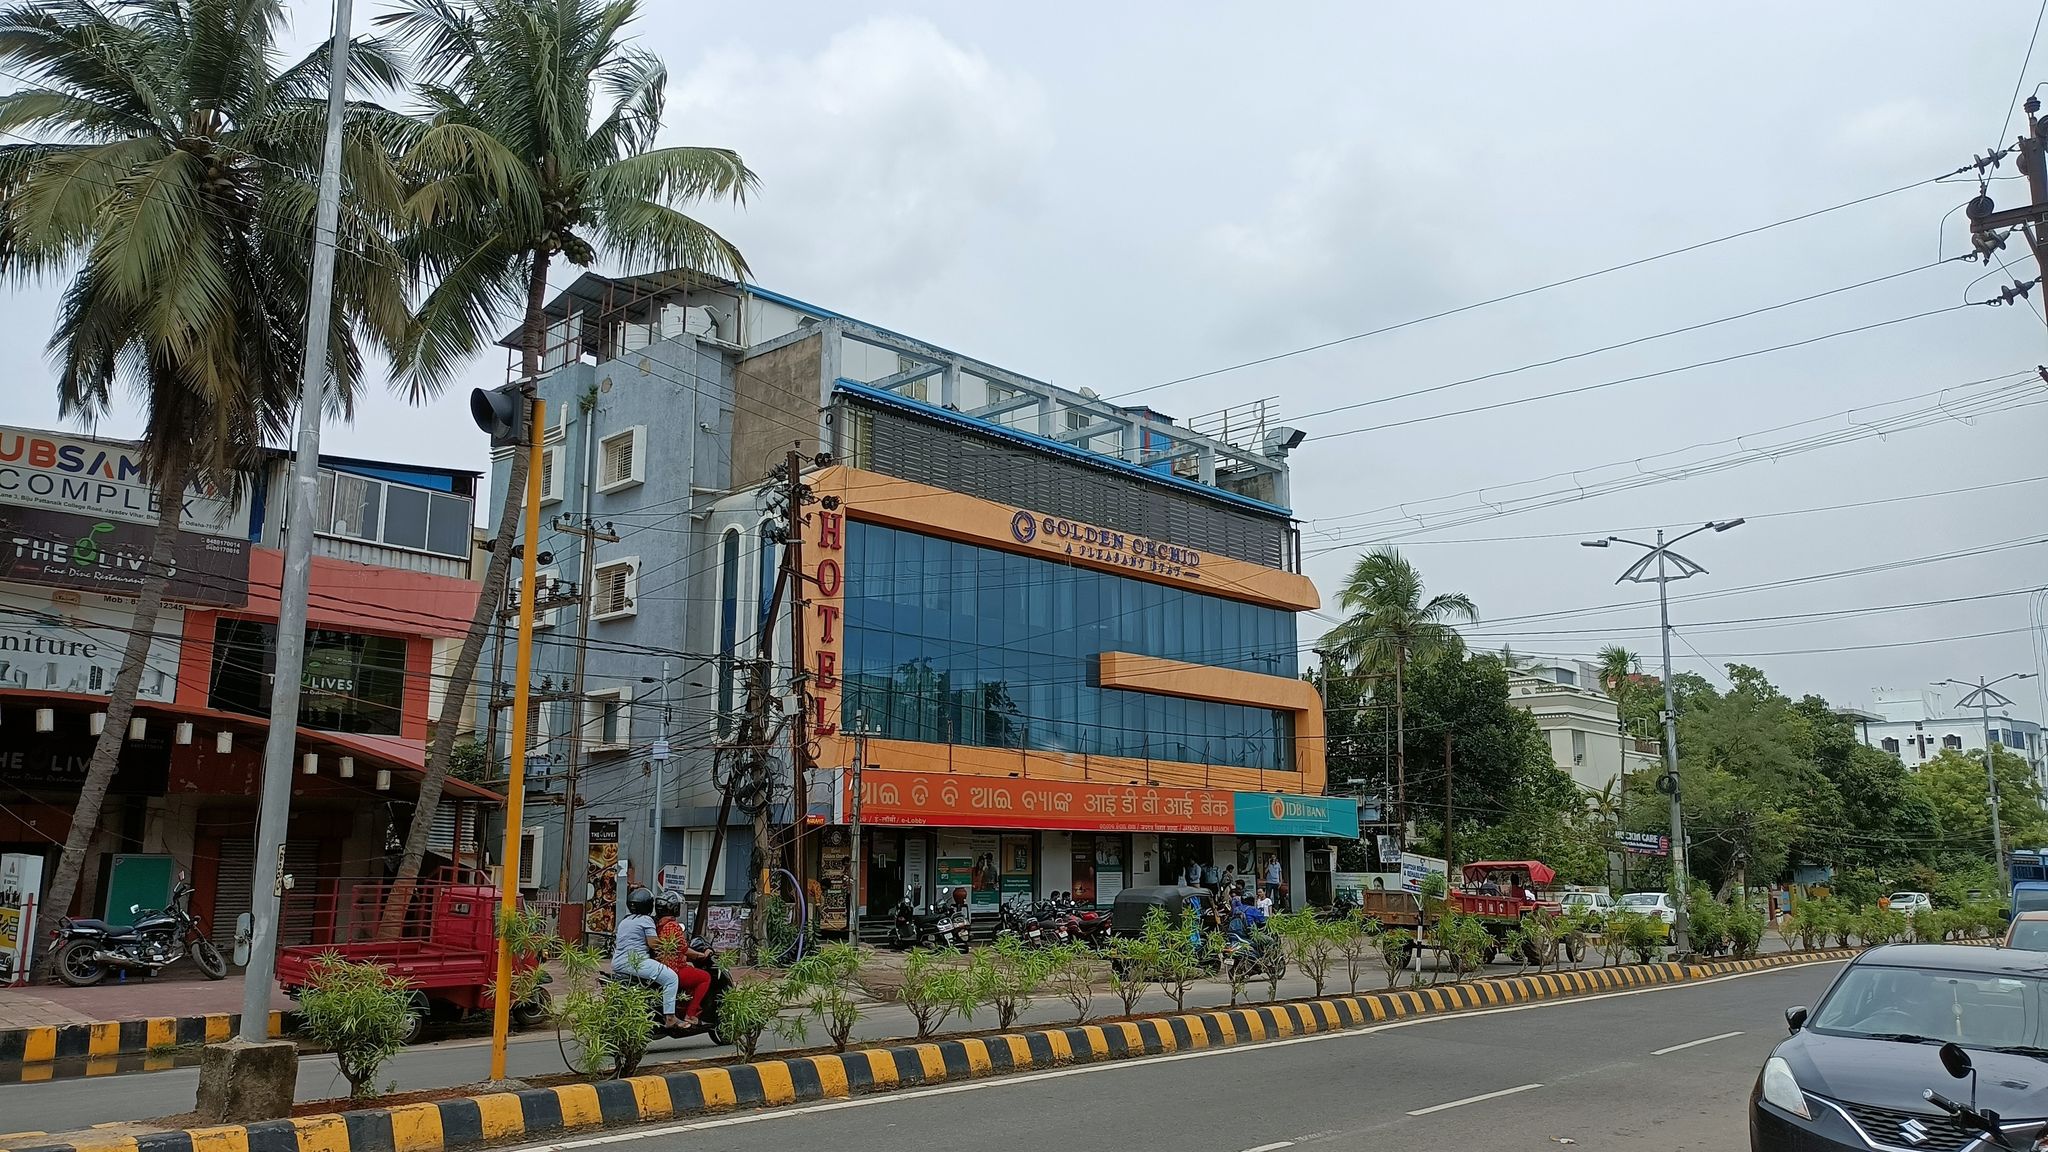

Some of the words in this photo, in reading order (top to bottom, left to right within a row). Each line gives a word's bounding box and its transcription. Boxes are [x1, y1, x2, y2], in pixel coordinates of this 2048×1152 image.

[63, 502, 85, 510] College
[12, 537, 69, 563] THE
[1042, 517, 1124, 550] GOLDEN
[1132, 538, 1200, 567] ORCHID
[1064, 541, 1073, 555] A
[1079, 545, 1145, 569] PLEASANT
[1151, 561, 1182, 577] STAY
[43, 565, 66, 574] Fine
[68, 567, 91, 577] Dine
[93, 571, 146, 585] Restaurant
[103, 595, 123, 604] Mob
[813, 510, 842, 736] HOTEL
[1083, 787, 1117, 816] आई
[1121, 787, 1139, 814] डी
[1142, 788, 1160, 815] बी
[1163, 791, 1195, 819] आई
[1199, 792, 1229, 816] बैंक
[1285, 802, 1305, 816] IDBI
[1306, 806, 1327, 818] BANK
[901, 816, 927, 824] e-Lobby
[1641, 833, 1659, 843] CARE
